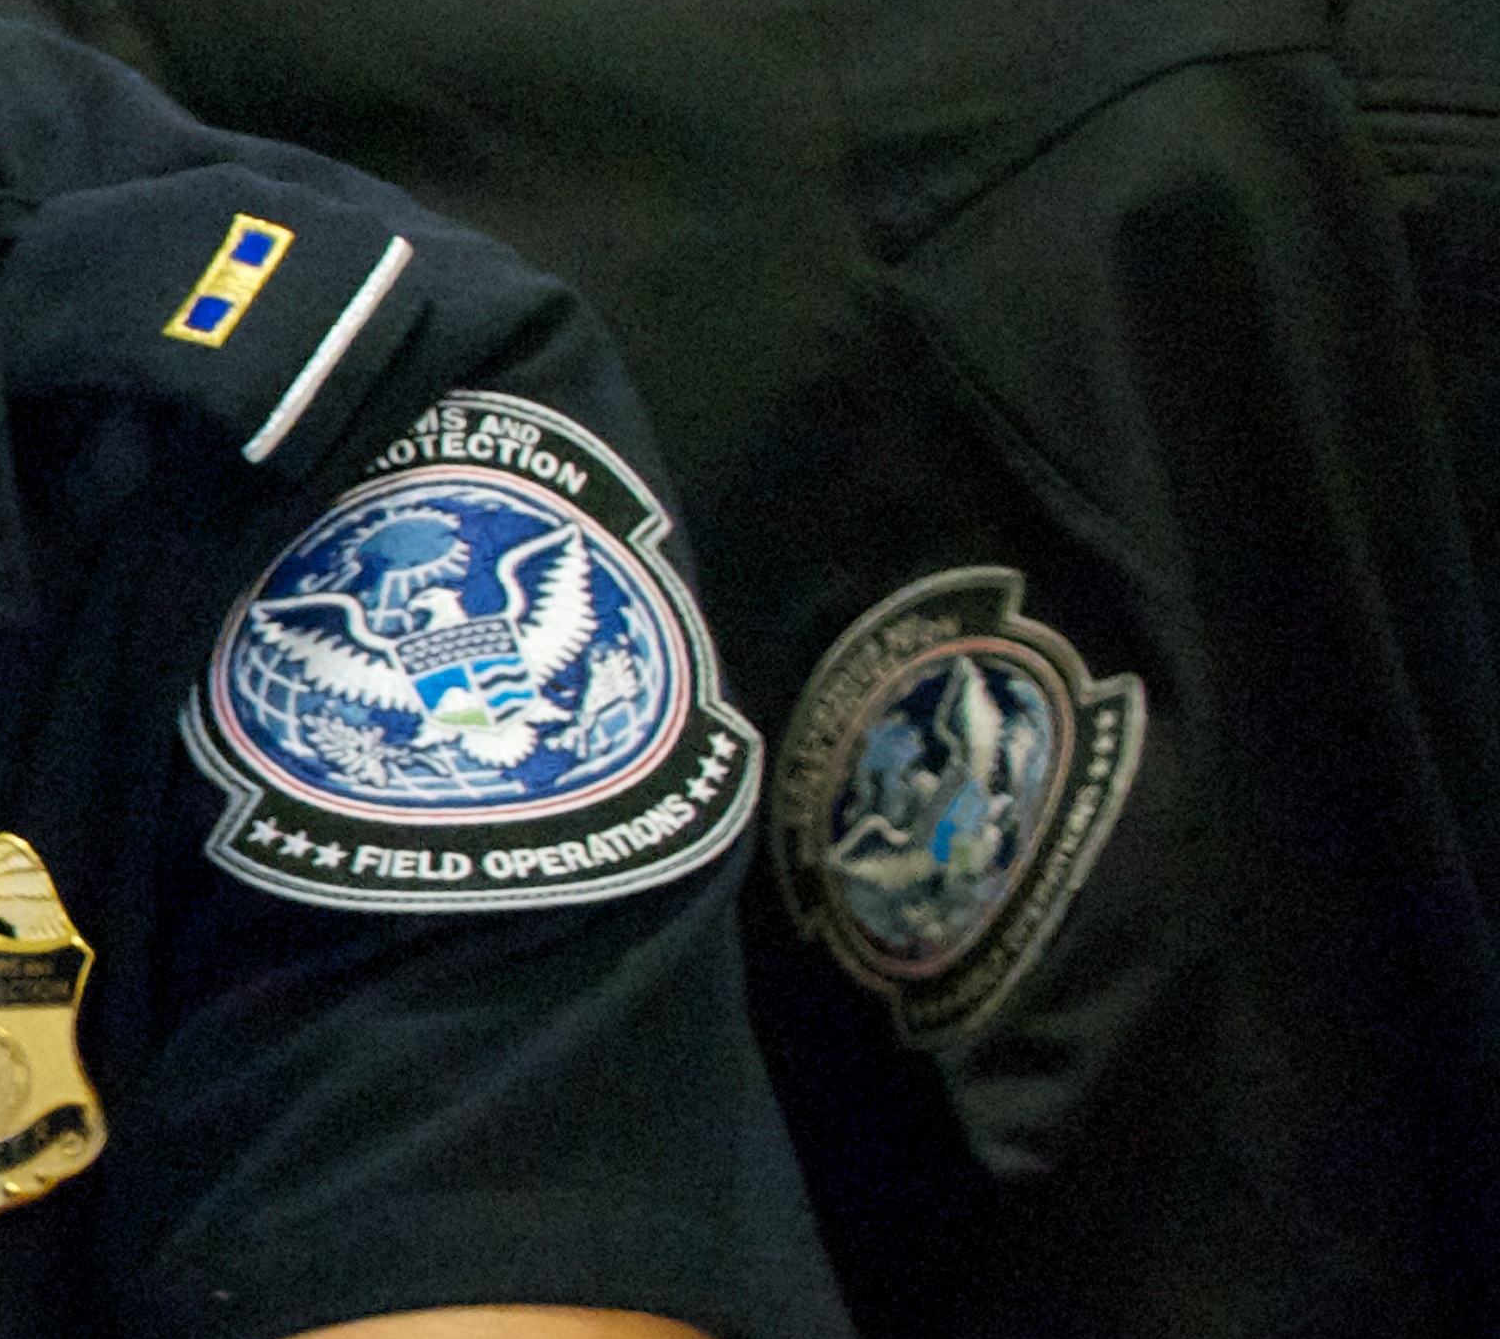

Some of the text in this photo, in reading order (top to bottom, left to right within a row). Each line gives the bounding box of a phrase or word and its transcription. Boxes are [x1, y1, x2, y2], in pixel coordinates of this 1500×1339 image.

[479, 414, 541, 445] AND
[366, 432, 588, 494] OTECTION
[352, 793, 697, 880] FIELD OPERATIONS
